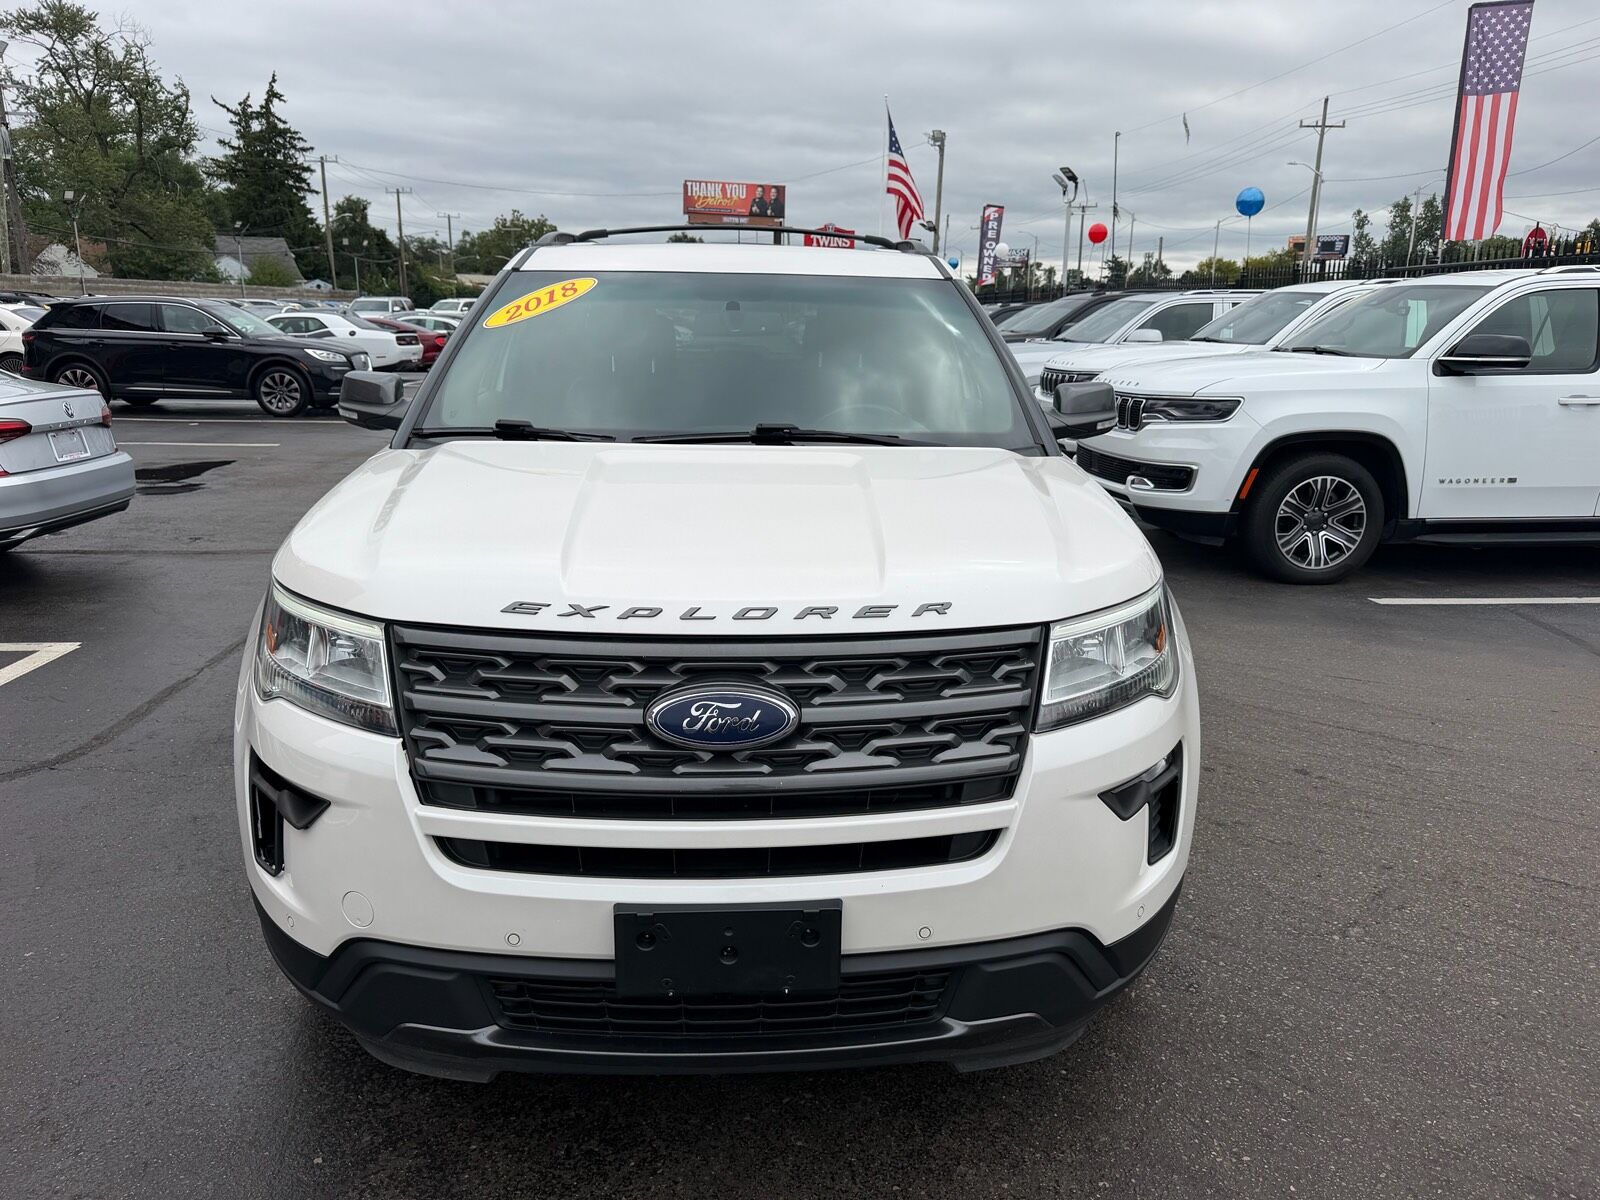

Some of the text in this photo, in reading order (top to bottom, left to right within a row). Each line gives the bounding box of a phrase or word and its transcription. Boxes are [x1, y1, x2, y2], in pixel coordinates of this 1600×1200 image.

[686, 181, 747, 199] THANK YOU
[810, 234, 851, 248] TWINS
[982, 212, 998, 280] PRE OWNED
[505, 281, 578, 322] 2018
[499, 600, 954, 621] EXPLORER
[682, 701, 762, 734] Ford
